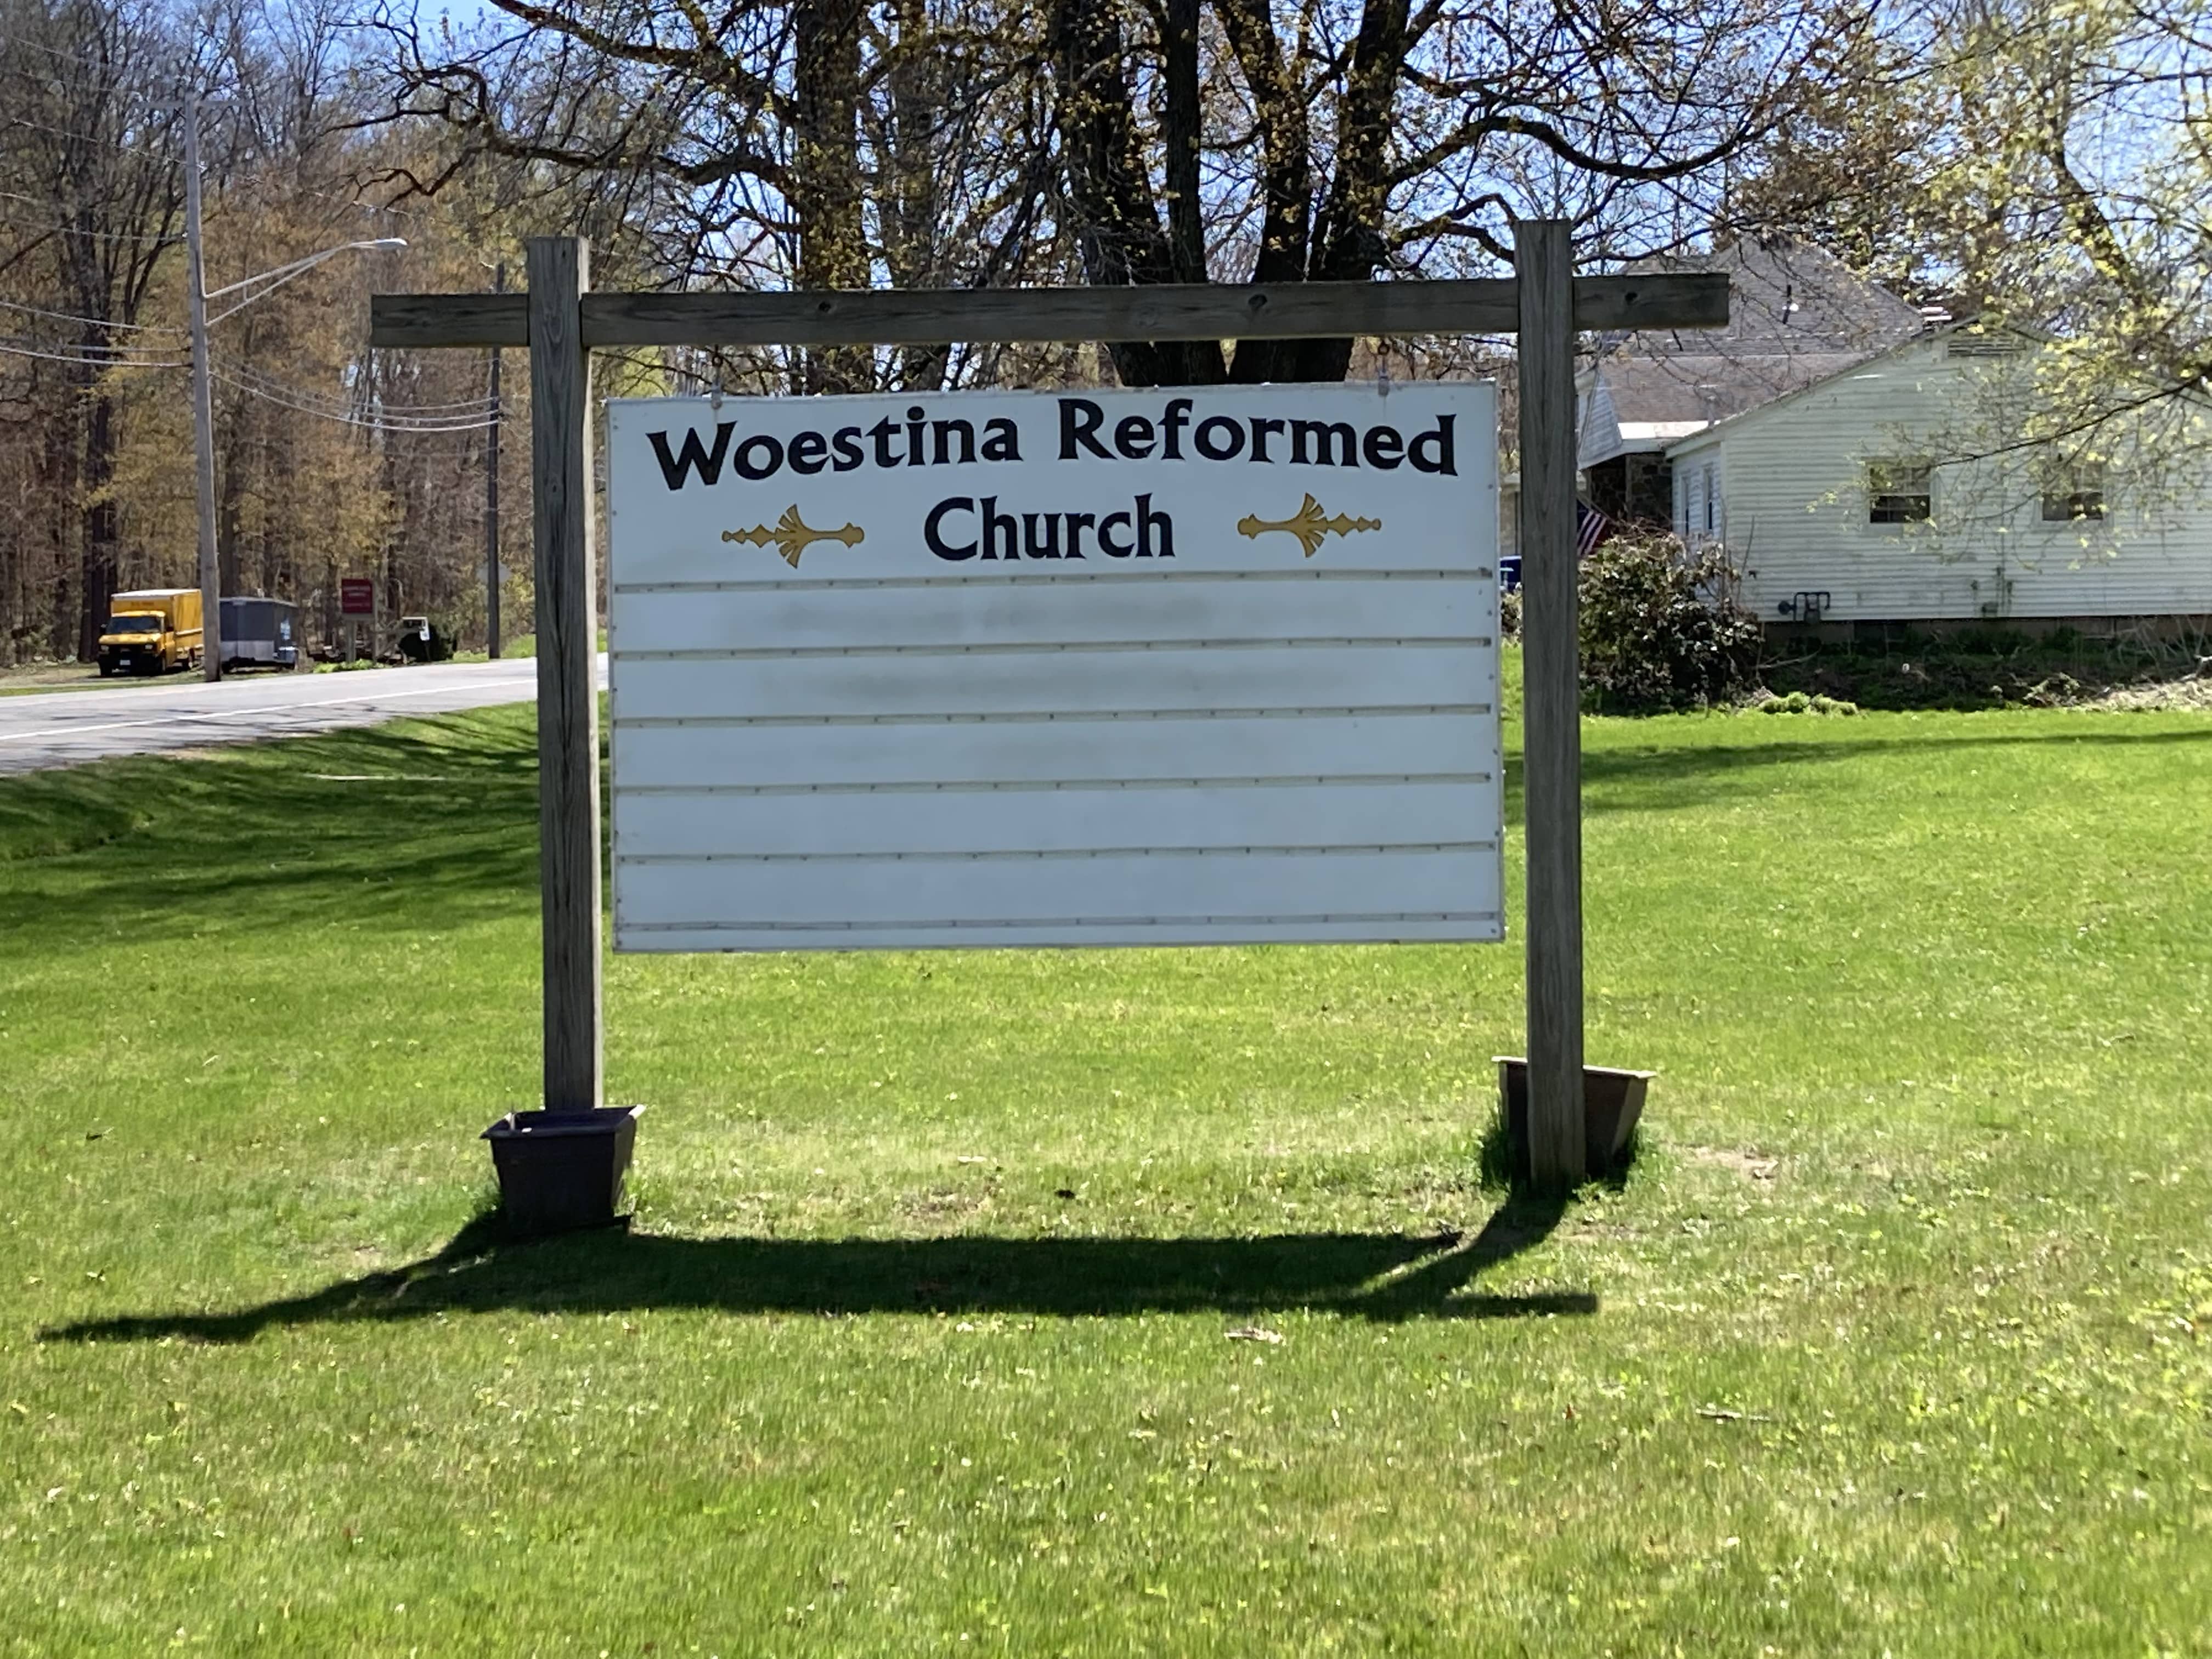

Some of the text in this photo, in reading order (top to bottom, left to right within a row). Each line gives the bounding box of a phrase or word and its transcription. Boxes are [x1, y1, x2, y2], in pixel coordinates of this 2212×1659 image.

[645, 398, 1458, 491] Woestina Reformed
[924, 493, 1176, 561] Church
